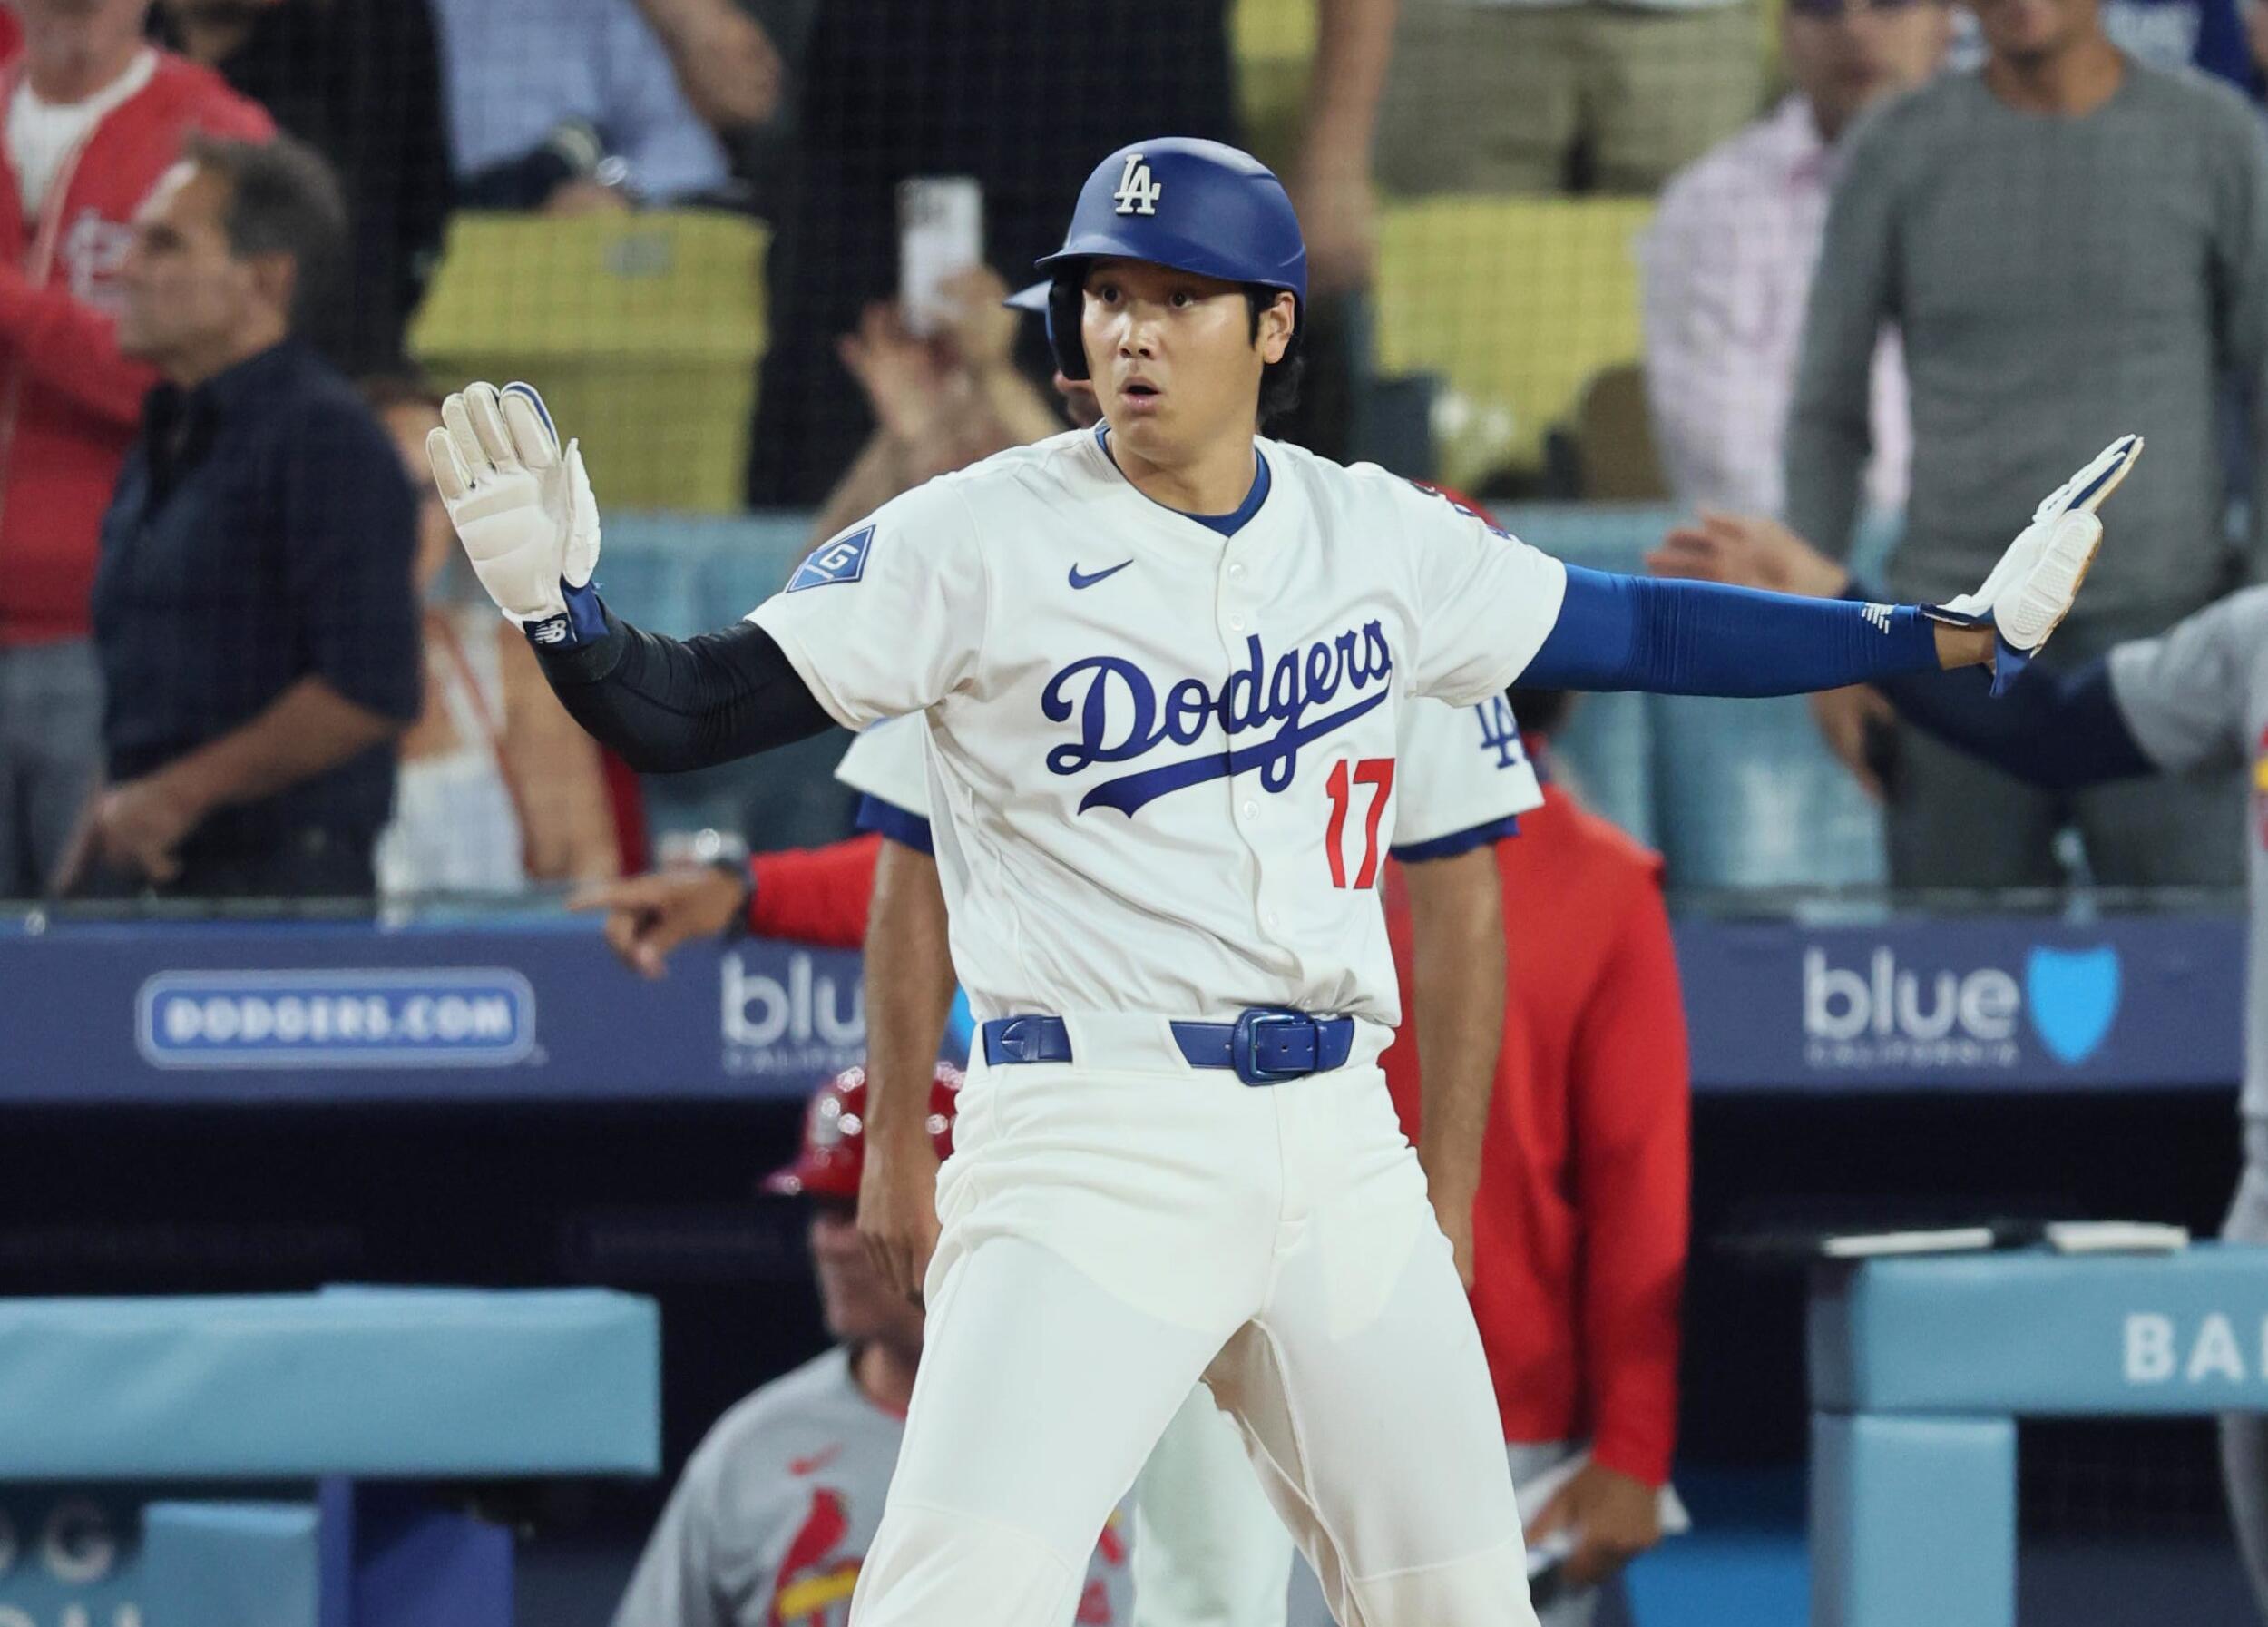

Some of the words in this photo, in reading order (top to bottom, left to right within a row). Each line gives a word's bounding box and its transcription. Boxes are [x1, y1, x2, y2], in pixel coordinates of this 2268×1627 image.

[1114, 153, 1161, 215] LA
[1041, 619, 1393, 793] Dodgers
[1325, 758, 1396, 889] 17
[165, 995, 515, 1044] DODGERS.COM
[721, 951, 867, 1046] blu
[1803, 946, 2021, 1040] blue
[2125, 1312, 2268, 1383] BA
